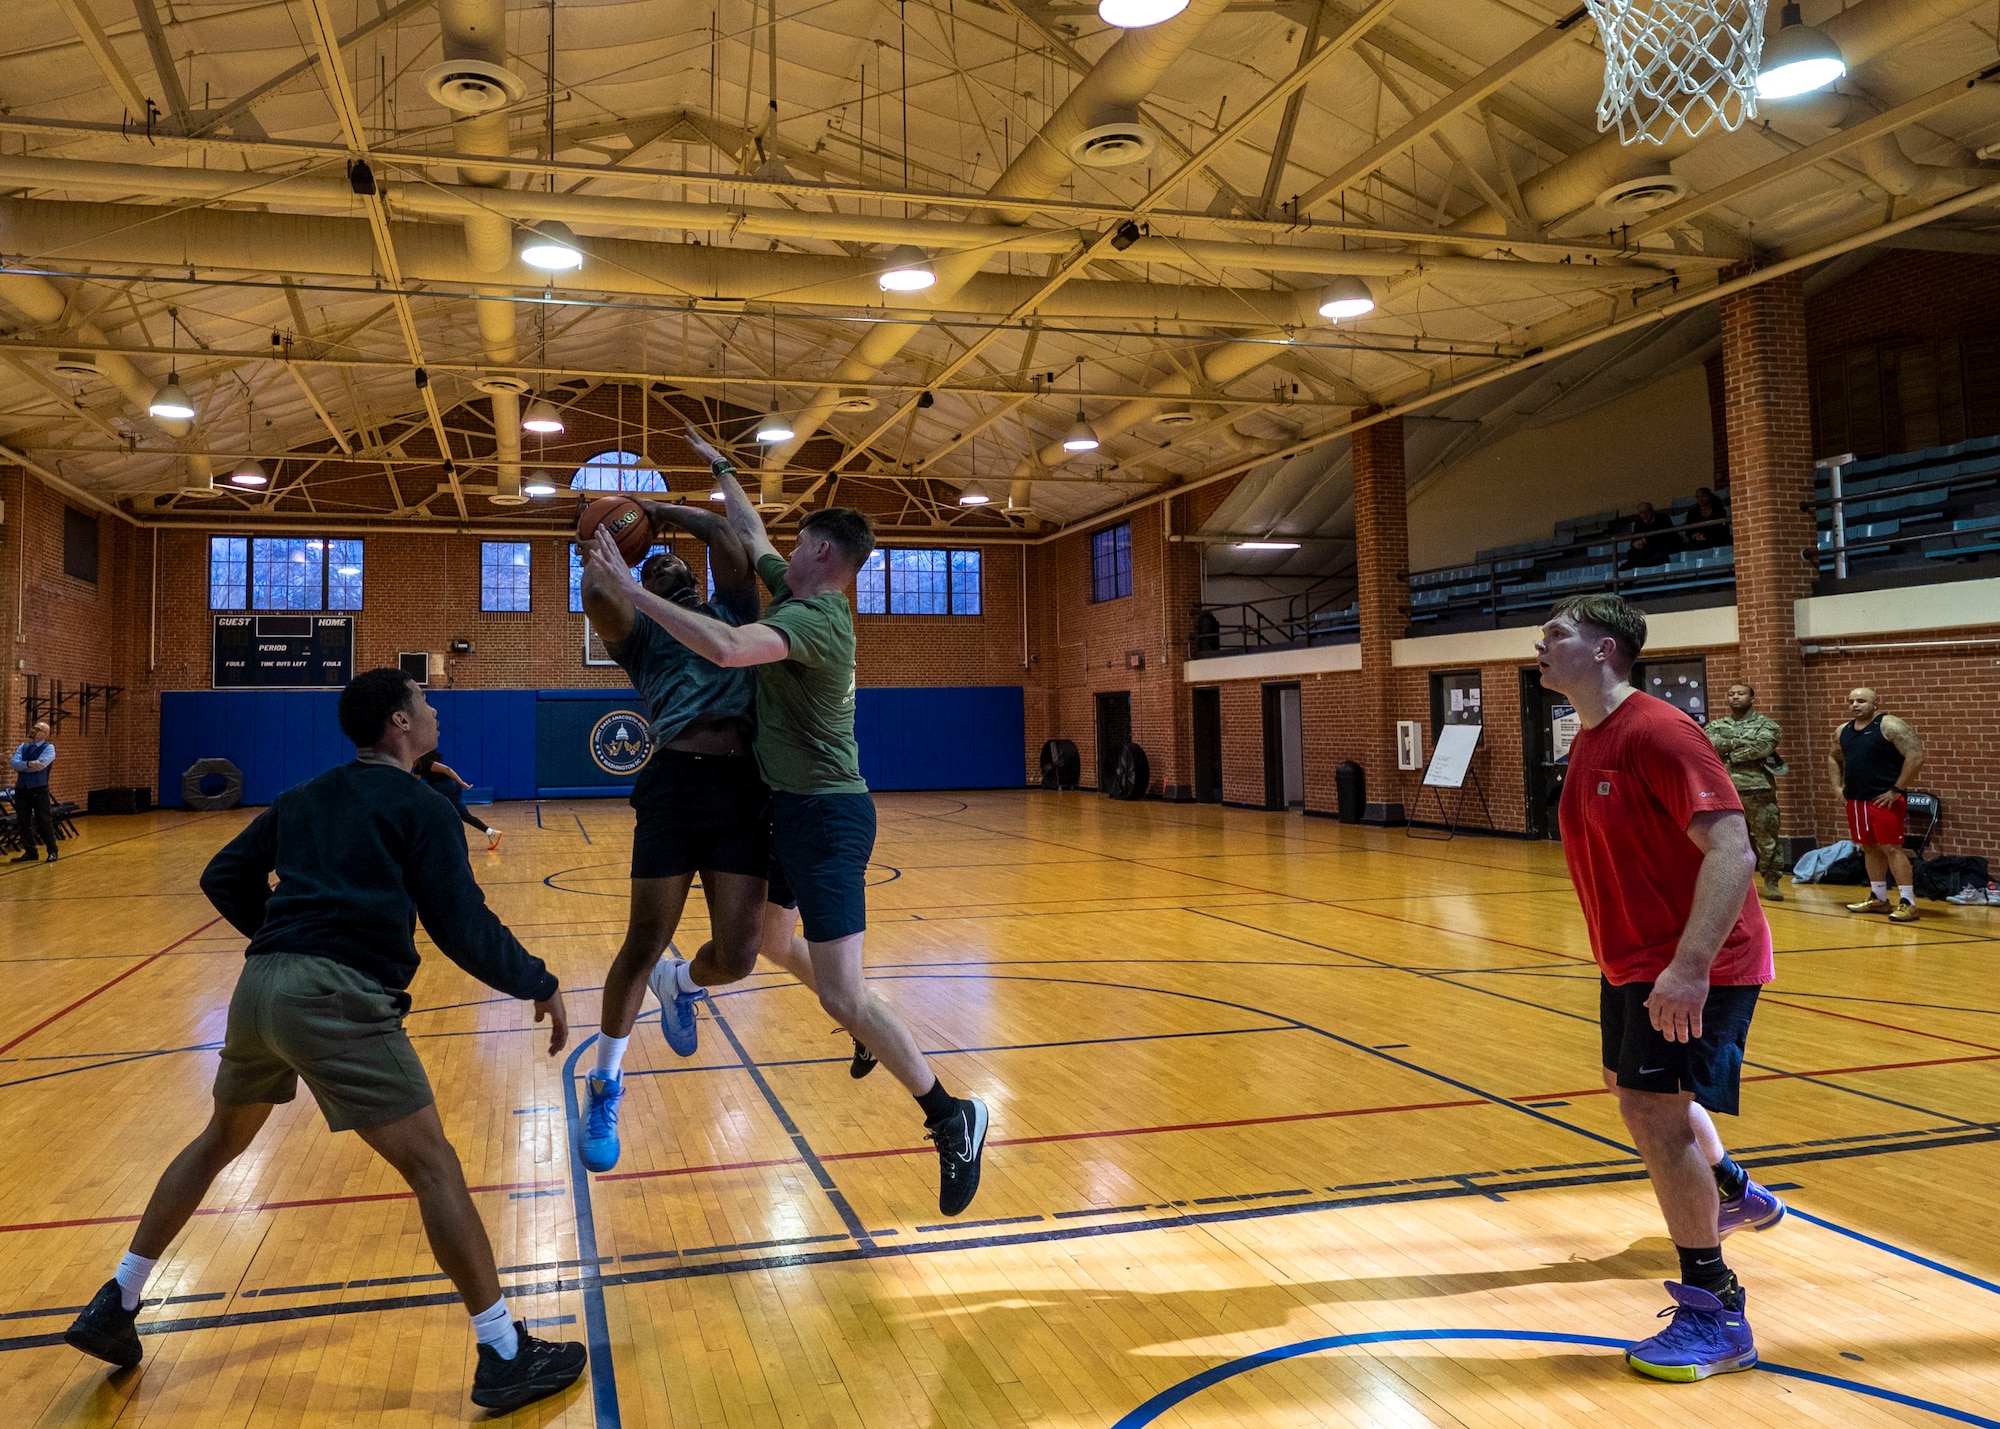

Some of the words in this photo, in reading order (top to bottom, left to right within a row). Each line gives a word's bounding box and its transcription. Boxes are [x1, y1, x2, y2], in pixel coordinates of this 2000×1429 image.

[608, 510, 639, 534] ilson
[219, 618, 251, 626] GUEST
[318, 618, 347, 626] HOME
[600, 718, 611, 730] BASE
[603, 759, 635, 770] WASHINGTON
